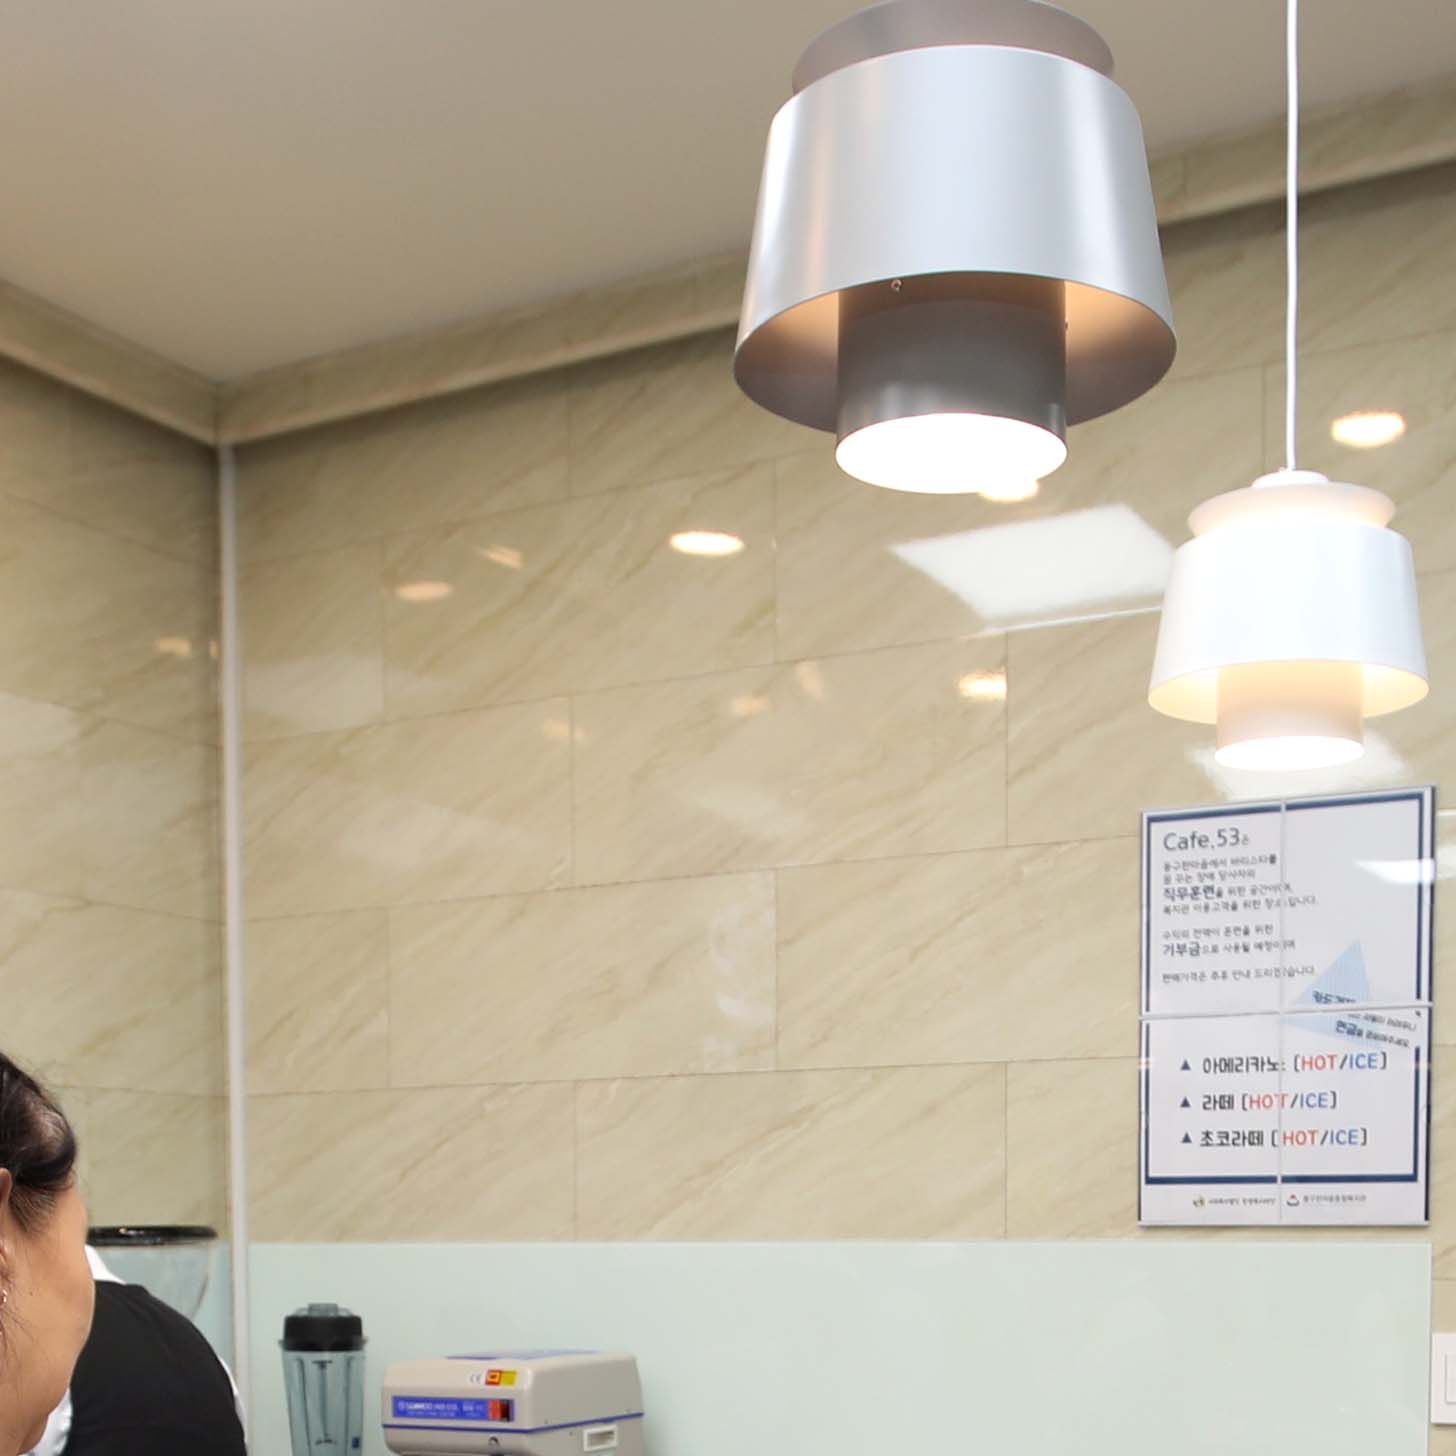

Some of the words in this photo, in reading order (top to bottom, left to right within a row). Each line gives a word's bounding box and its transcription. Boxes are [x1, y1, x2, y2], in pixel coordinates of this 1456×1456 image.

[1202, 1056, 1280, 1075] 아메리카노
[1202, 1094, 1234, 1112] 라떼
[1200, 1129, 1264, 1148] 초코라떼
